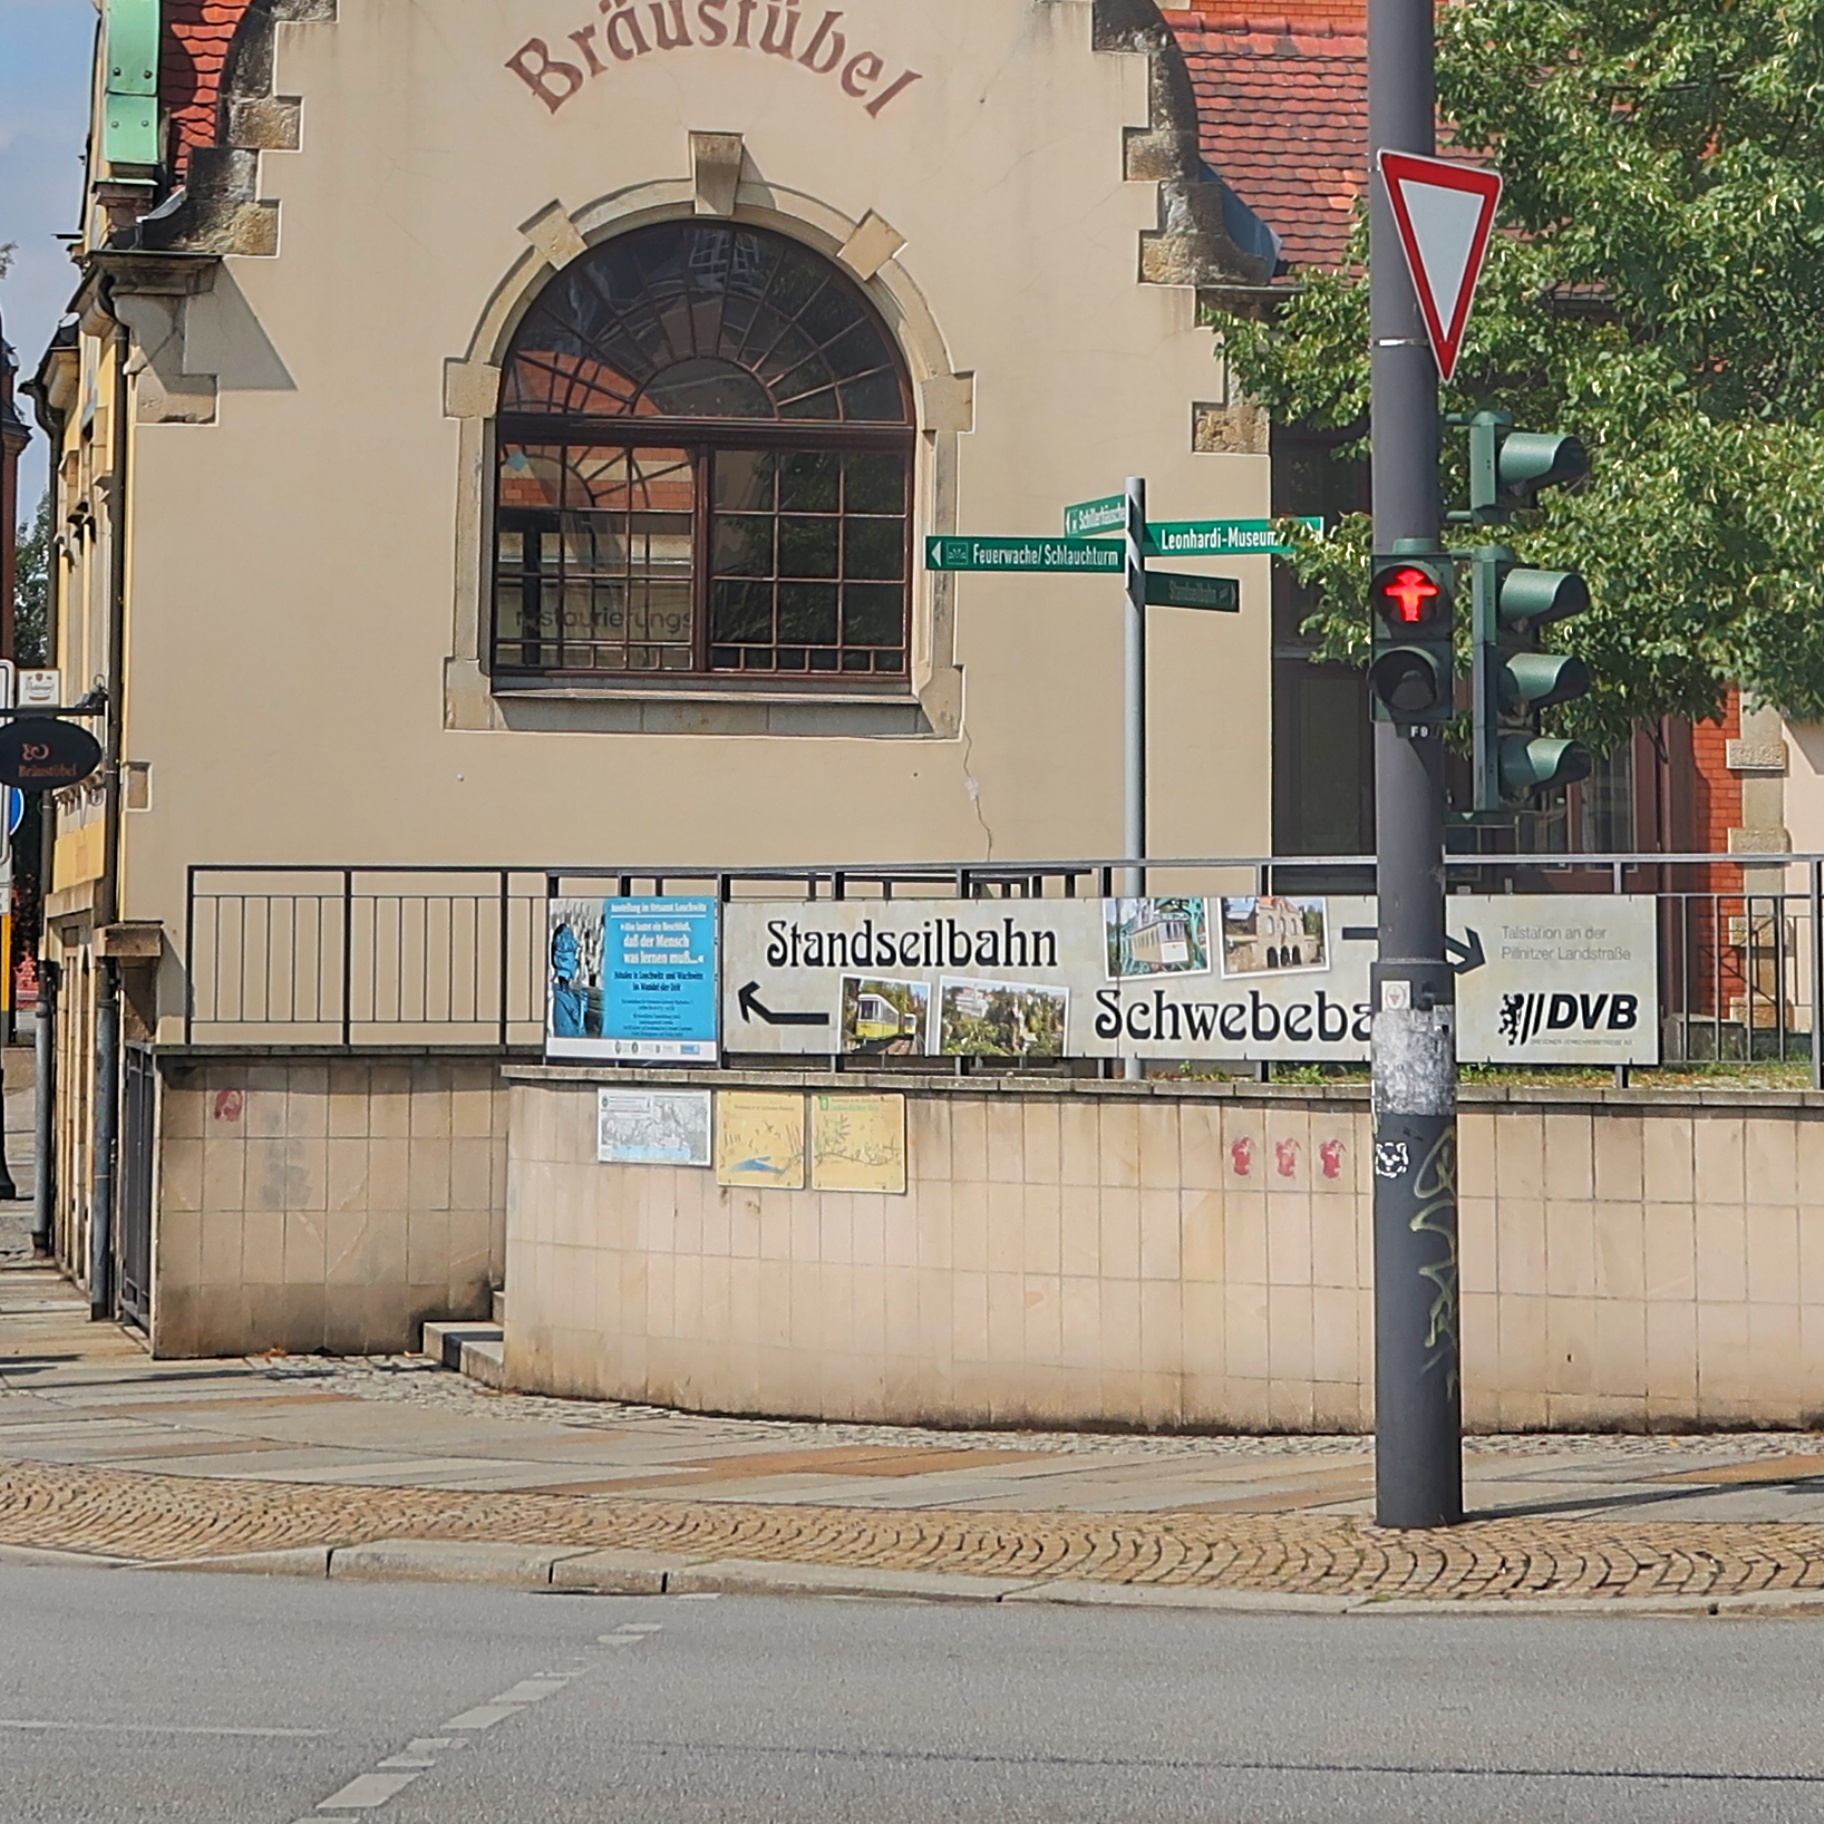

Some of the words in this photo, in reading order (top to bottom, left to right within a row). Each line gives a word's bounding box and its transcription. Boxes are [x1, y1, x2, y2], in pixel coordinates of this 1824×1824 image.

[1161, 528, 1277, 550] Leonhardi-Museum
[1044, 543, 1118, 566] Schlauchturm
[766, 919, 1058, 968] Standseilbahn
[1502, 926, 1562, 940] Talstation
[1565, 929, 1581, 940] an
[1585, 926, 1606, 940] der
[1501, 946, 1554, 960] Pillnitzer
[1558, 946, 1631, 961] Landstraße
[1094, 989, 1373, 1042] Schwebeba
[1546, 993, 1638, 1030] DVB
